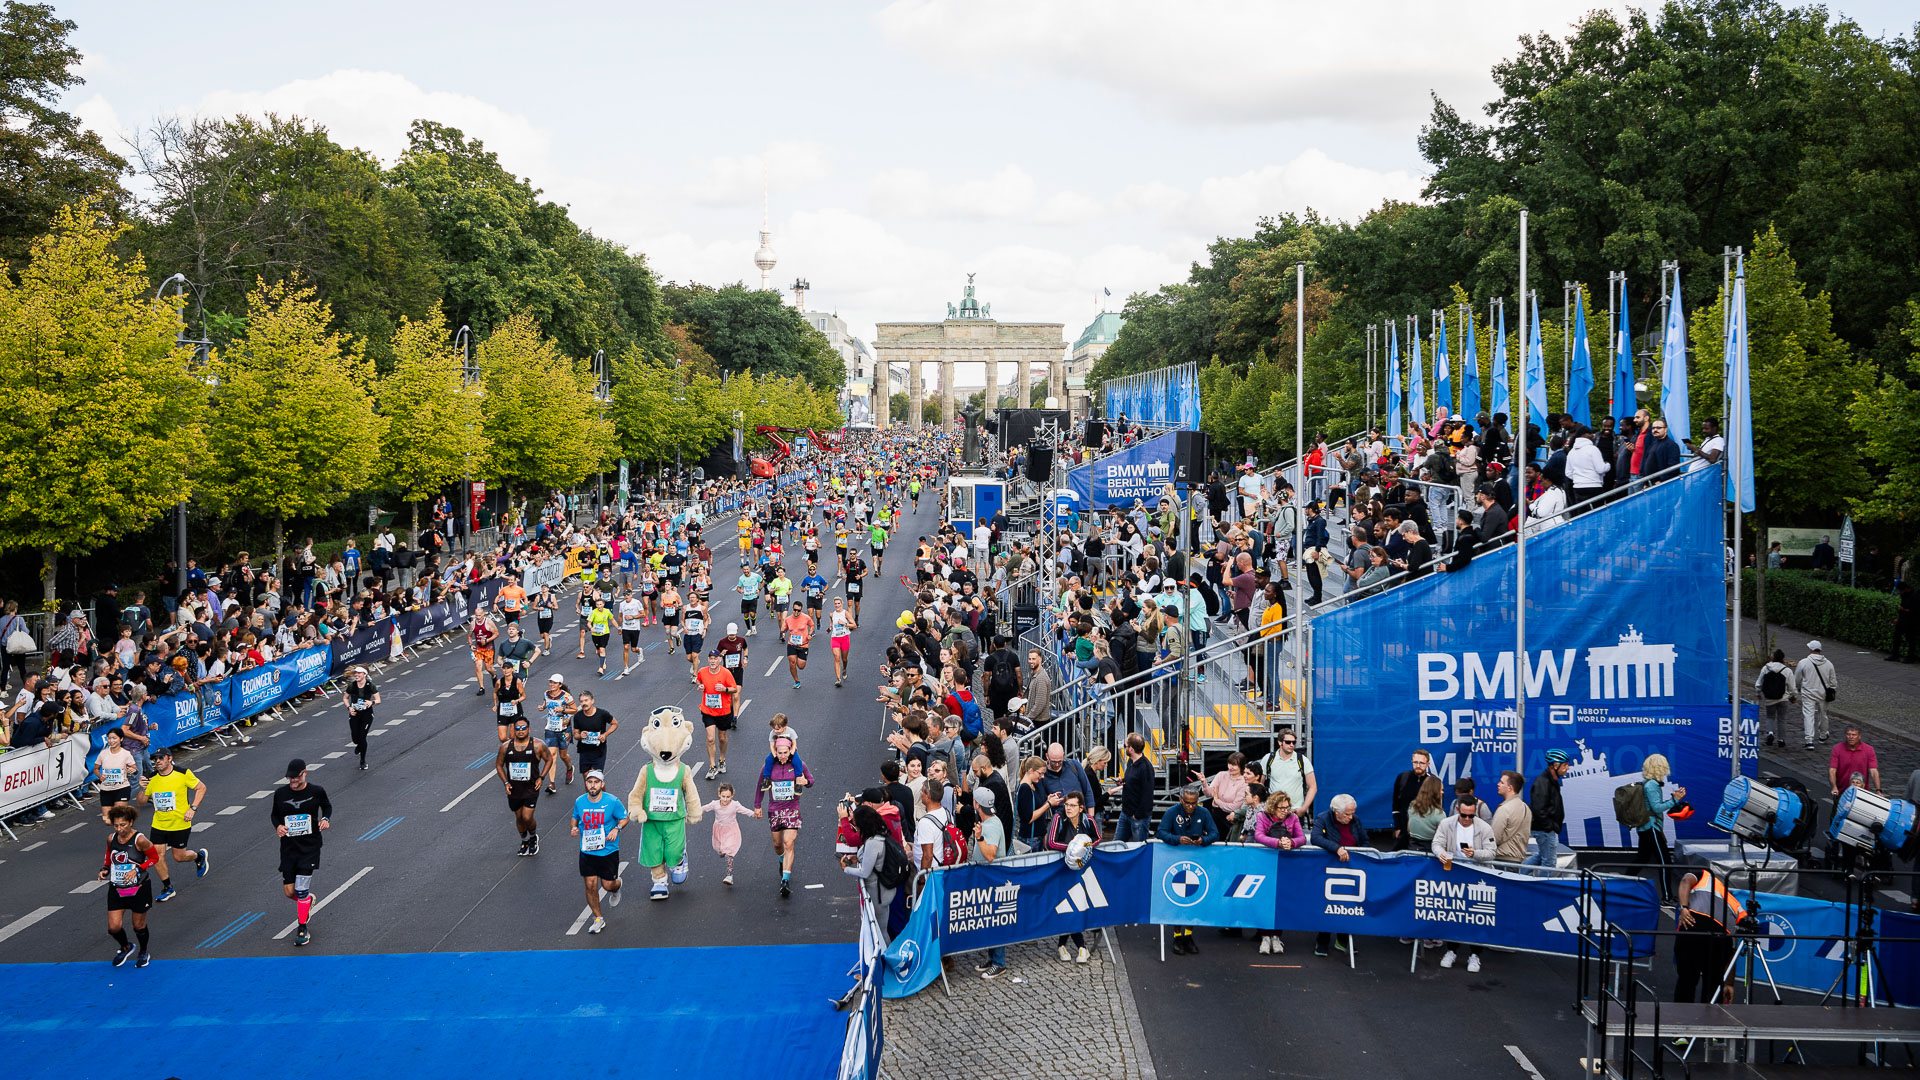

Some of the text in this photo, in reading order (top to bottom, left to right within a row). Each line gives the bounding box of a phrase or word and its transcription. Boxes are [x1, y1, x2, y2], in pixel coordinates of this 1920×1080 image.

[1107, 464, 1145, 477] BMW
[1107, 477, 1147, 488] BERLIN
[242, 671, 273, 695] ERDINGER
[1418, 648, 1577, 700] BMW
[242, 684, 283, 708] ALKOHOLFREI
[1608, 716, 1655, 724] MARATHON
[1658, 718, 1692, 726] MAJORS
[4, 764, 44, 793] BERLIN
[582, 812, 605, 825] CHI
[1169, 863, 1204, 876] BMW
[950, 886, 994, 908] BMW
[1415, 879, 1466, 899] BMW
[950, 903, 993, 921] BERLIN
[1324, 904, 1365, 916] Abbott
[1415, 896, 1466, 911] BERLIN
[949, 912, 1017, 934] MARATHON
[1415, 909, 1496, 927] MARATHON
